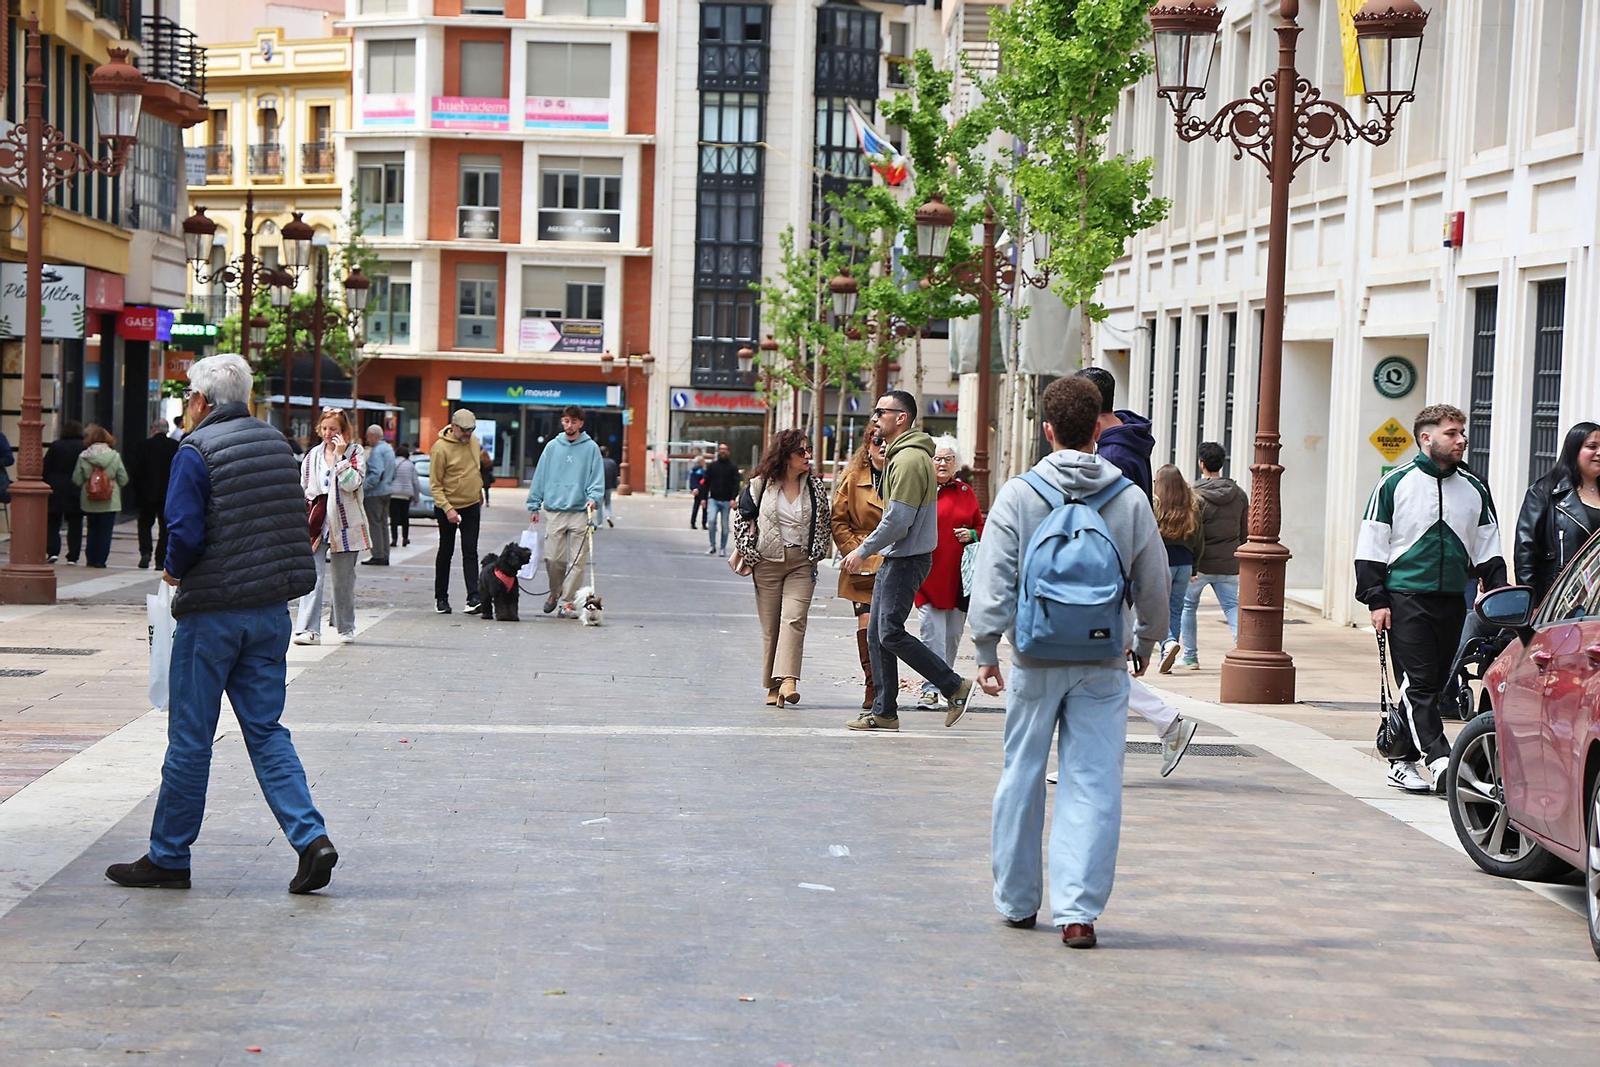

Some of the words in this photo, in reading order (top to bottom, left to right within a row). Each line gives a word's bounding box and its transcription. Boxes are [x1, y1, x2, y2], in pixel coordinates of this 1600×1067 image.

[437, 98, 508, 113] huelvaderm
[41, 285, 81, 301] Ultra
[125, 316, 154, 327] GAES
[525, 387, 562, 397] movistar
[1377, 435, 1407, 444] SEGUROS
